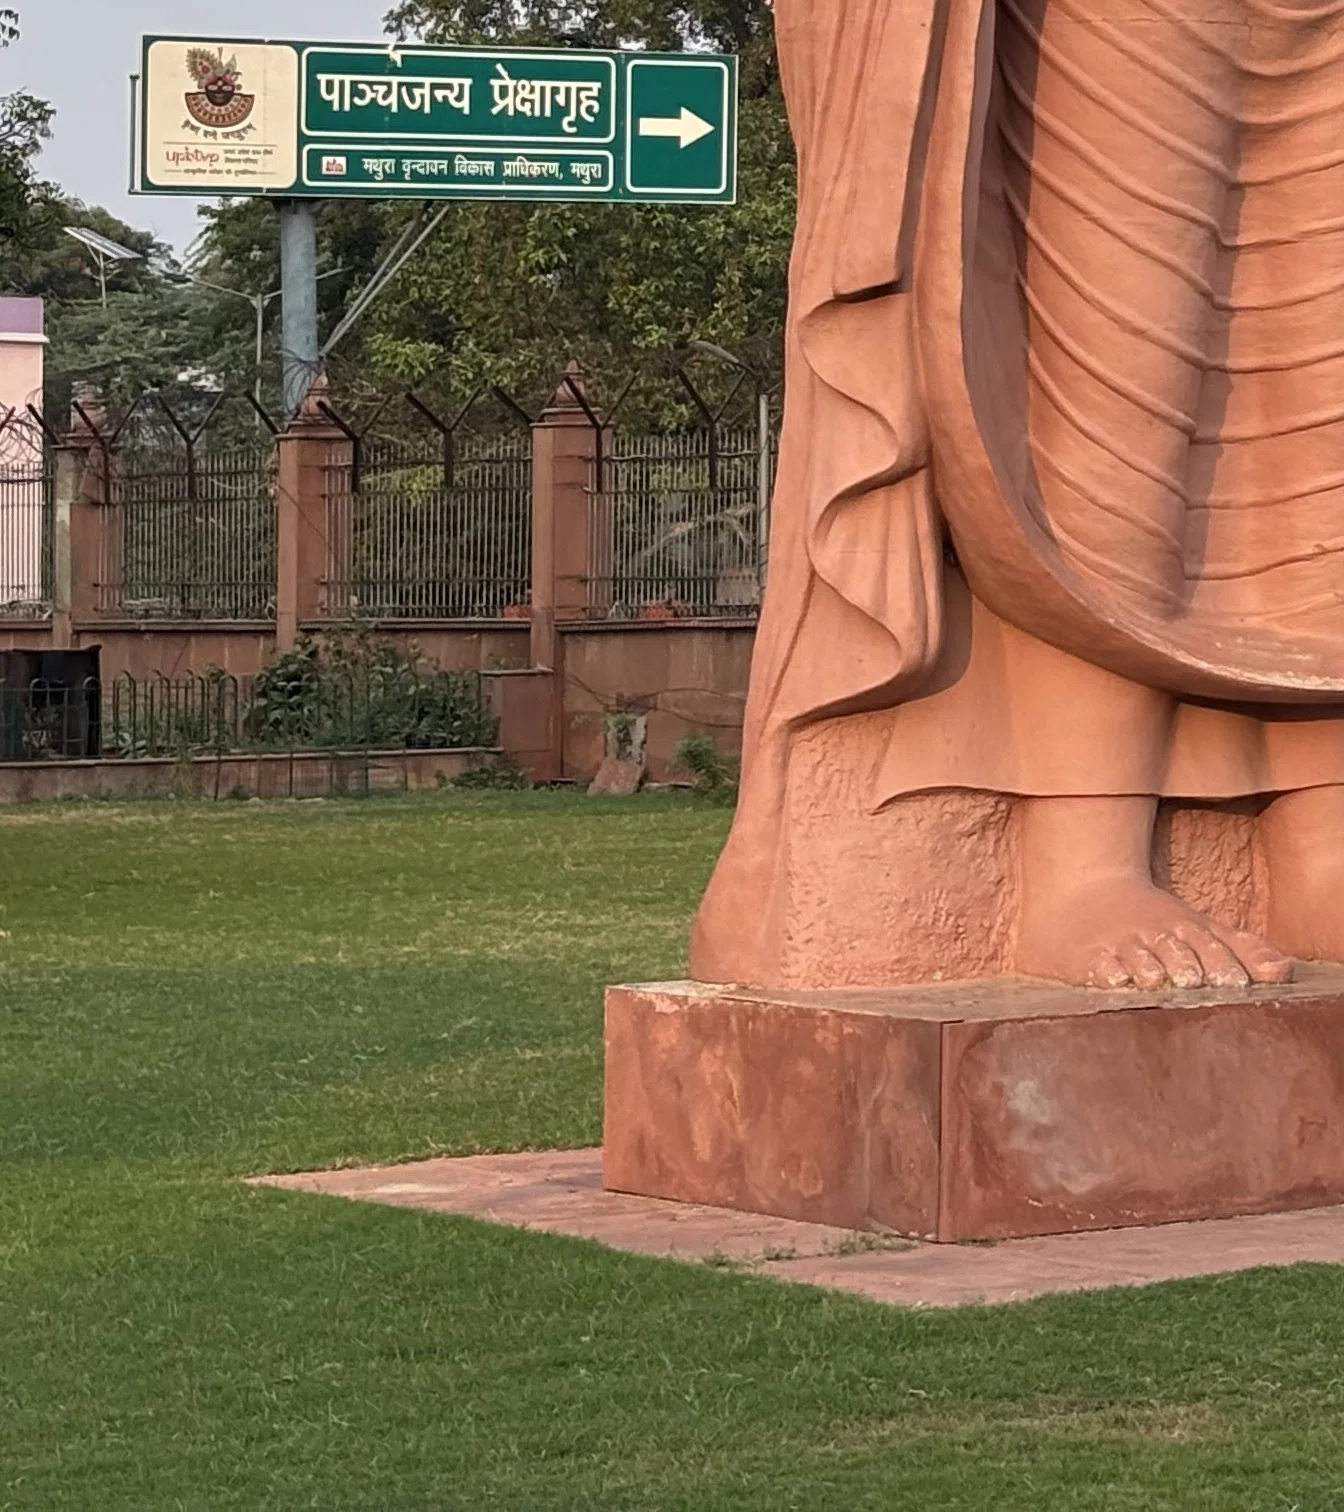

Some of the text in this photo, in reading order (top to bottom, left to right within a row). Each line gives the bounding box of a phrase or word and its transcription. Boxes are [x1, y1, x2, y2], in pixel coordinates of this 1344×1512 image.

[316, 63, 602, 133] पाञ्चजन्य प्रेक्षागृह
[361, 158, 396, 181] मथुरा
[454, 154, 495, 177] विकास
[569, 162, 602, 185] मथुरा
